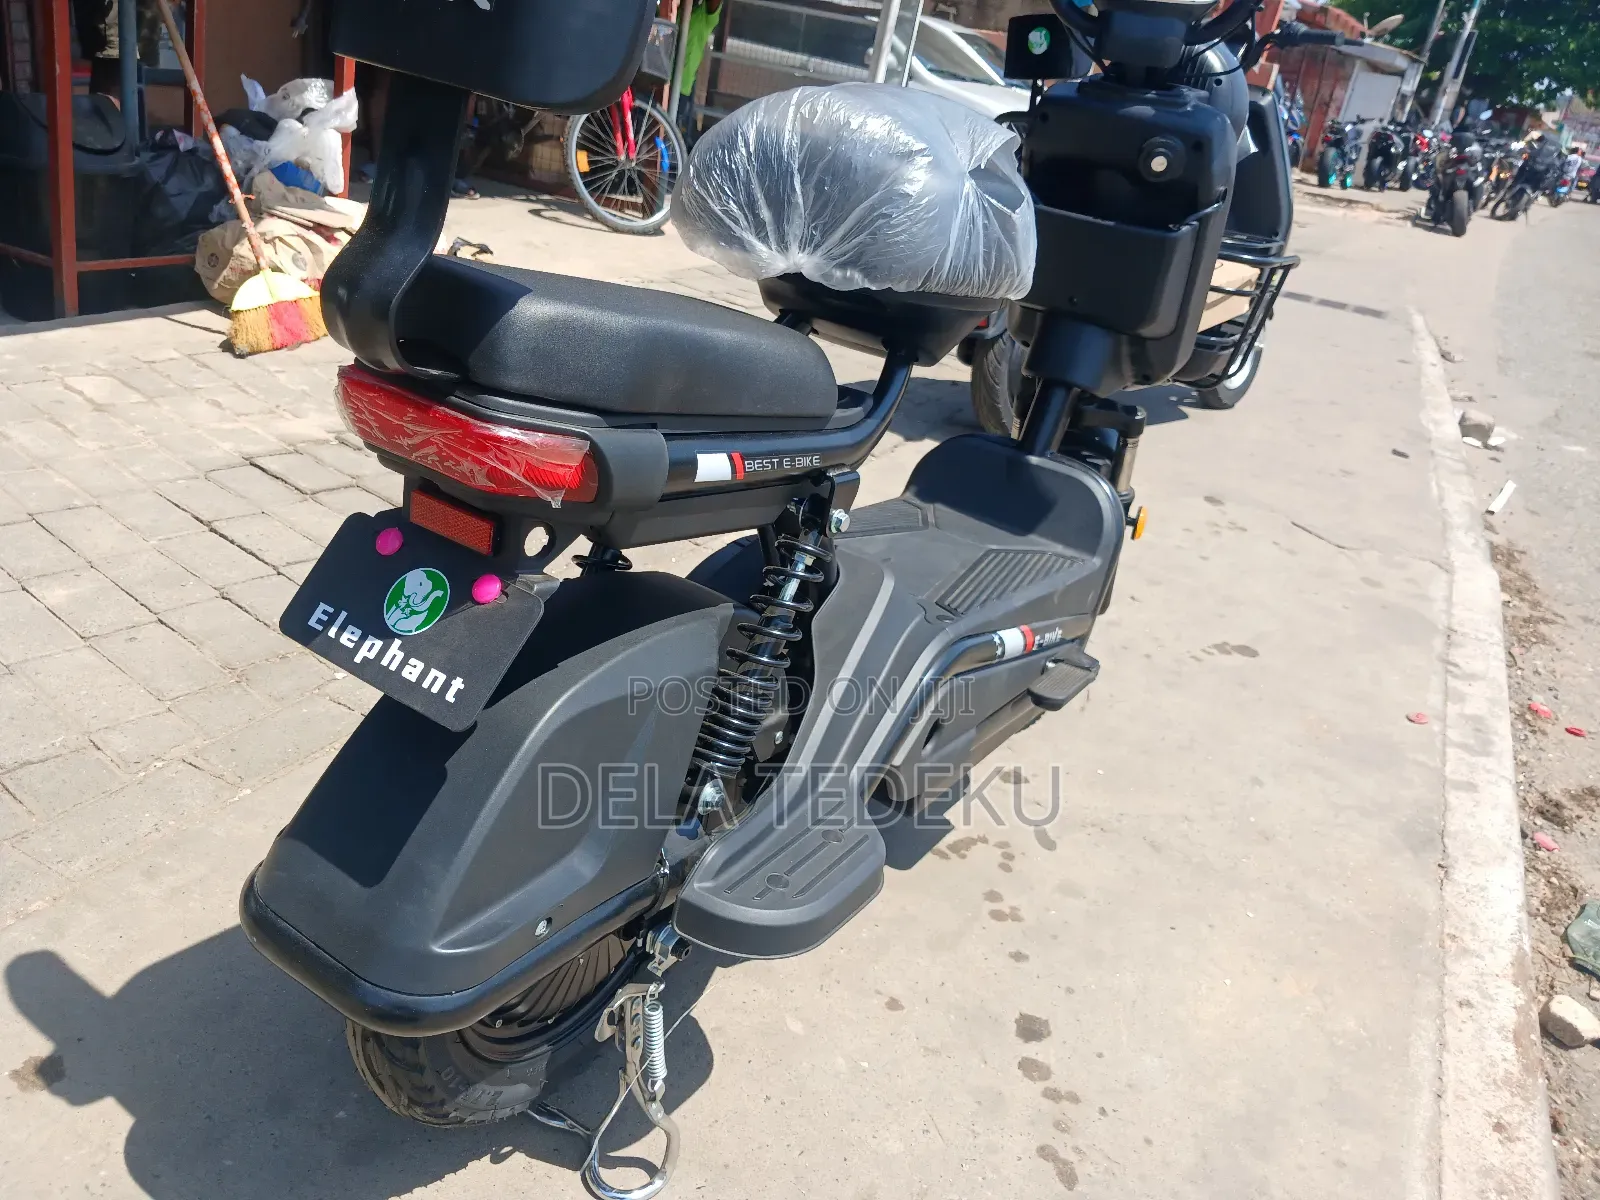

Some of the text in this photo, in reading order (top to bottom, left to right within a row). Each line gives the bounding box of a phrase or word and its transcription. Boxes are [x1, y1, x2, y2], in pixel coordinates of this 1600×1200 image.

[745, 455, 821, 472] BEST E-BIKE
[307, 601, 465, 703] Elephant
